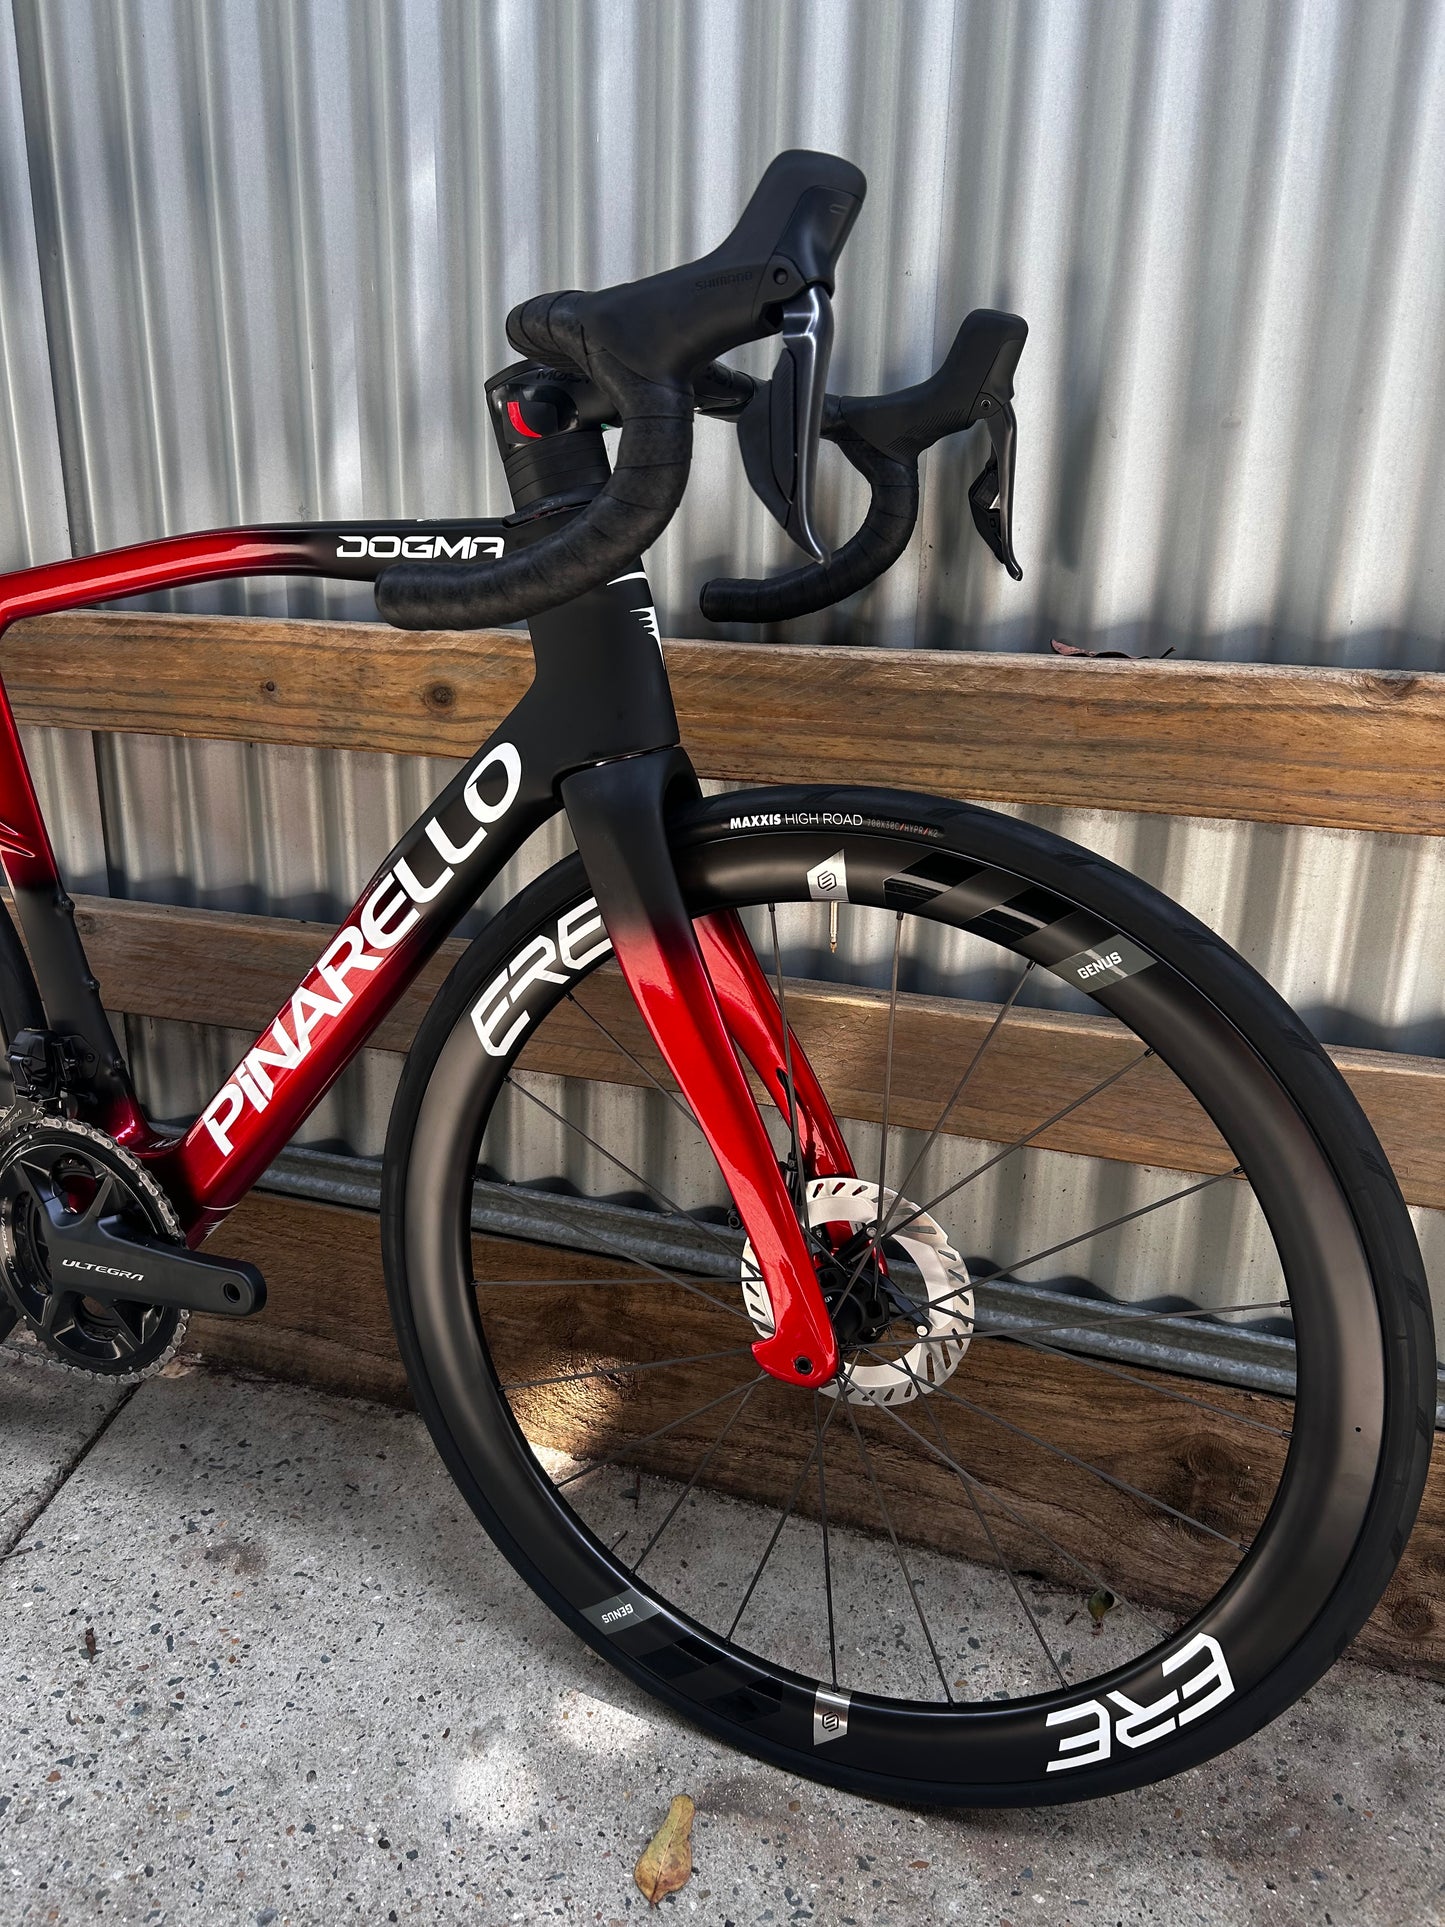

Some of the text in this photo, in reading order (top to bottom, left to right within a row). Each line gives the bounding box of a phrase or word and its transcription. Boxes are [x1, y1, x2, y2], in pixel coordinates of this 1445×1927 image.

[695, 271, 753, 291] SHIMANO
[336, 535, 505, 559] DOGMA
[730, 813, 782, 830] MAXXIS
[784, 813, 820, 826] HIGH
[822, 813, 863, 827] ROAD
[470, 896, 613, 1057] ERE
[1077, 951, 1122, 979] GENUS
[62, 1259, 145, 1281] ULTEGRA
[601, 1603, 634, 1624] GENUS
[1045, 1632, 1236, 1772] ERE
